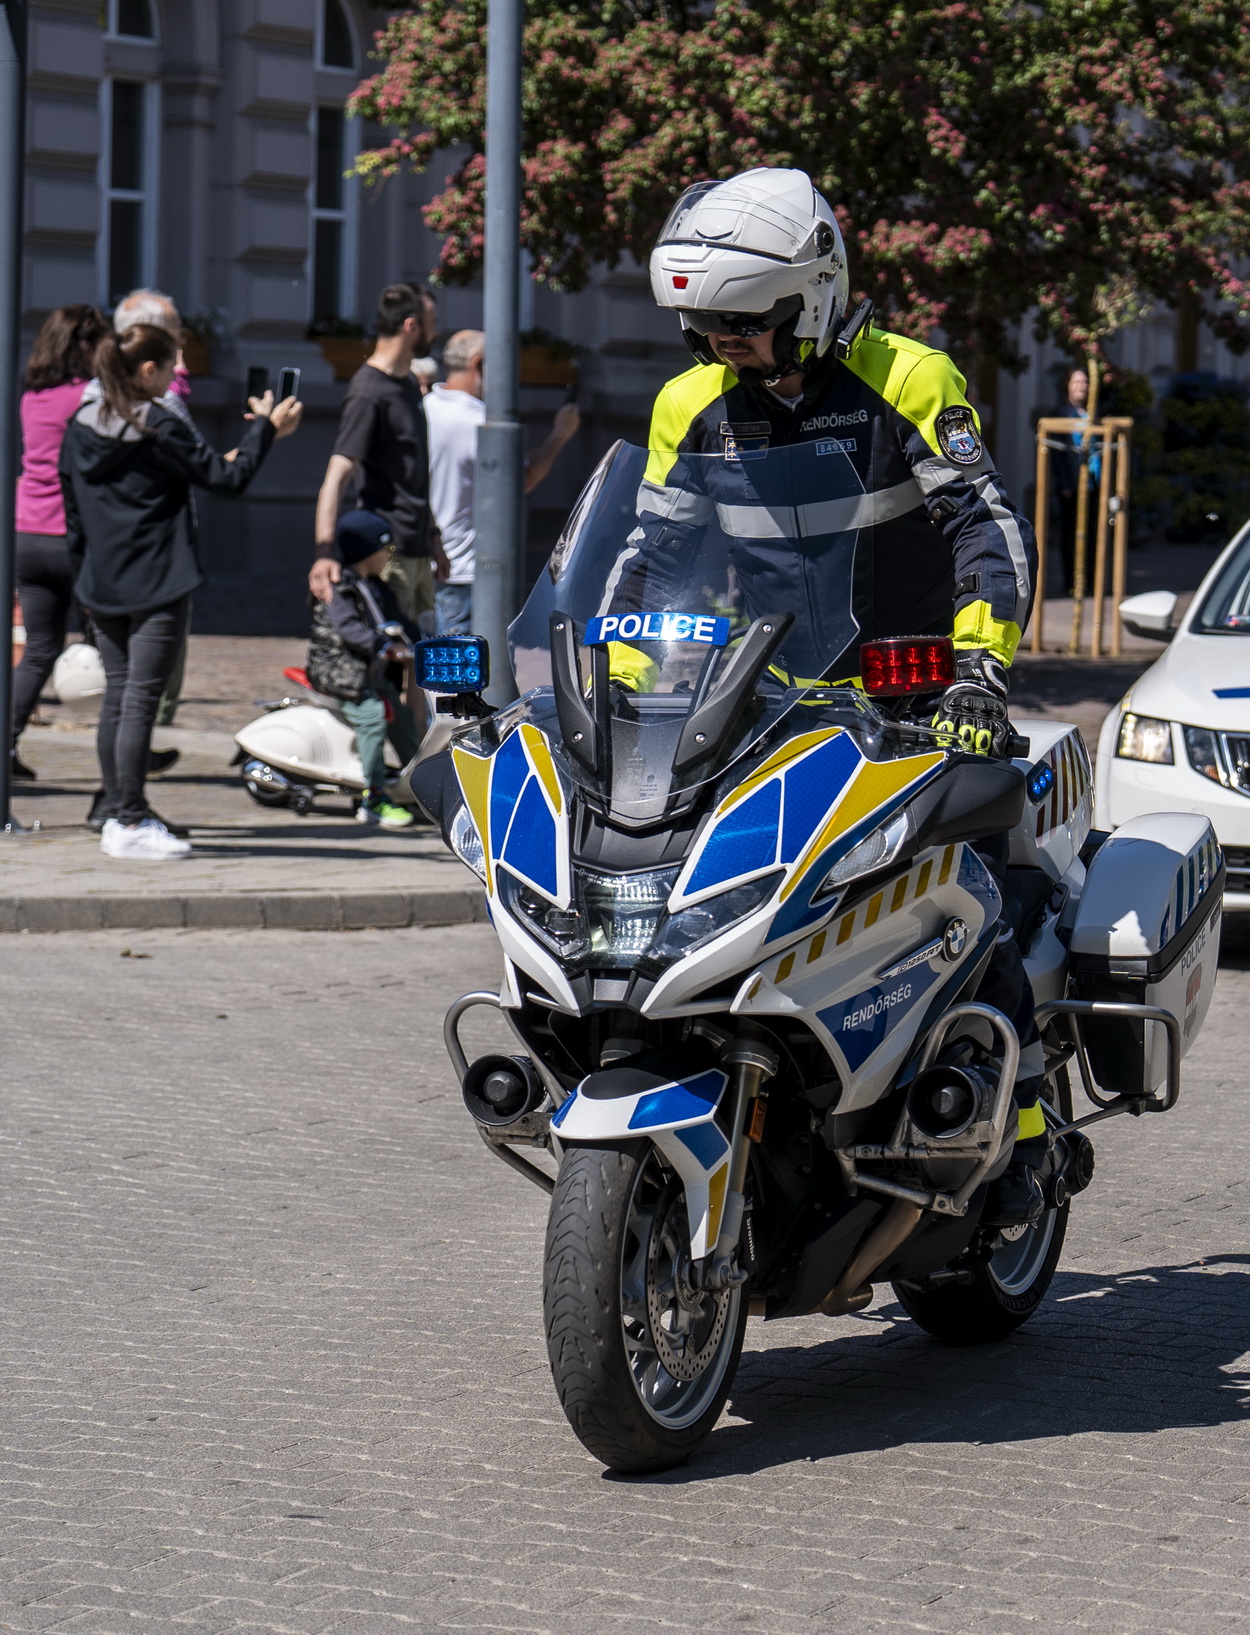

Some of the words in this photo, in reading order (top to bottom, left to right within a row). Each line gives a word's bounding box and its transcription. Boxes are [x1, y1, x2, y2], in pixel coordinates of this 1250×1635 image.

[599, 614, 716, 642] POLICE
[1181, 927, 1206, 977] POLICE
[843, 983, 912, 1031] RENDŐRSÉG
[746, 1217, 755, 1261] brembo
